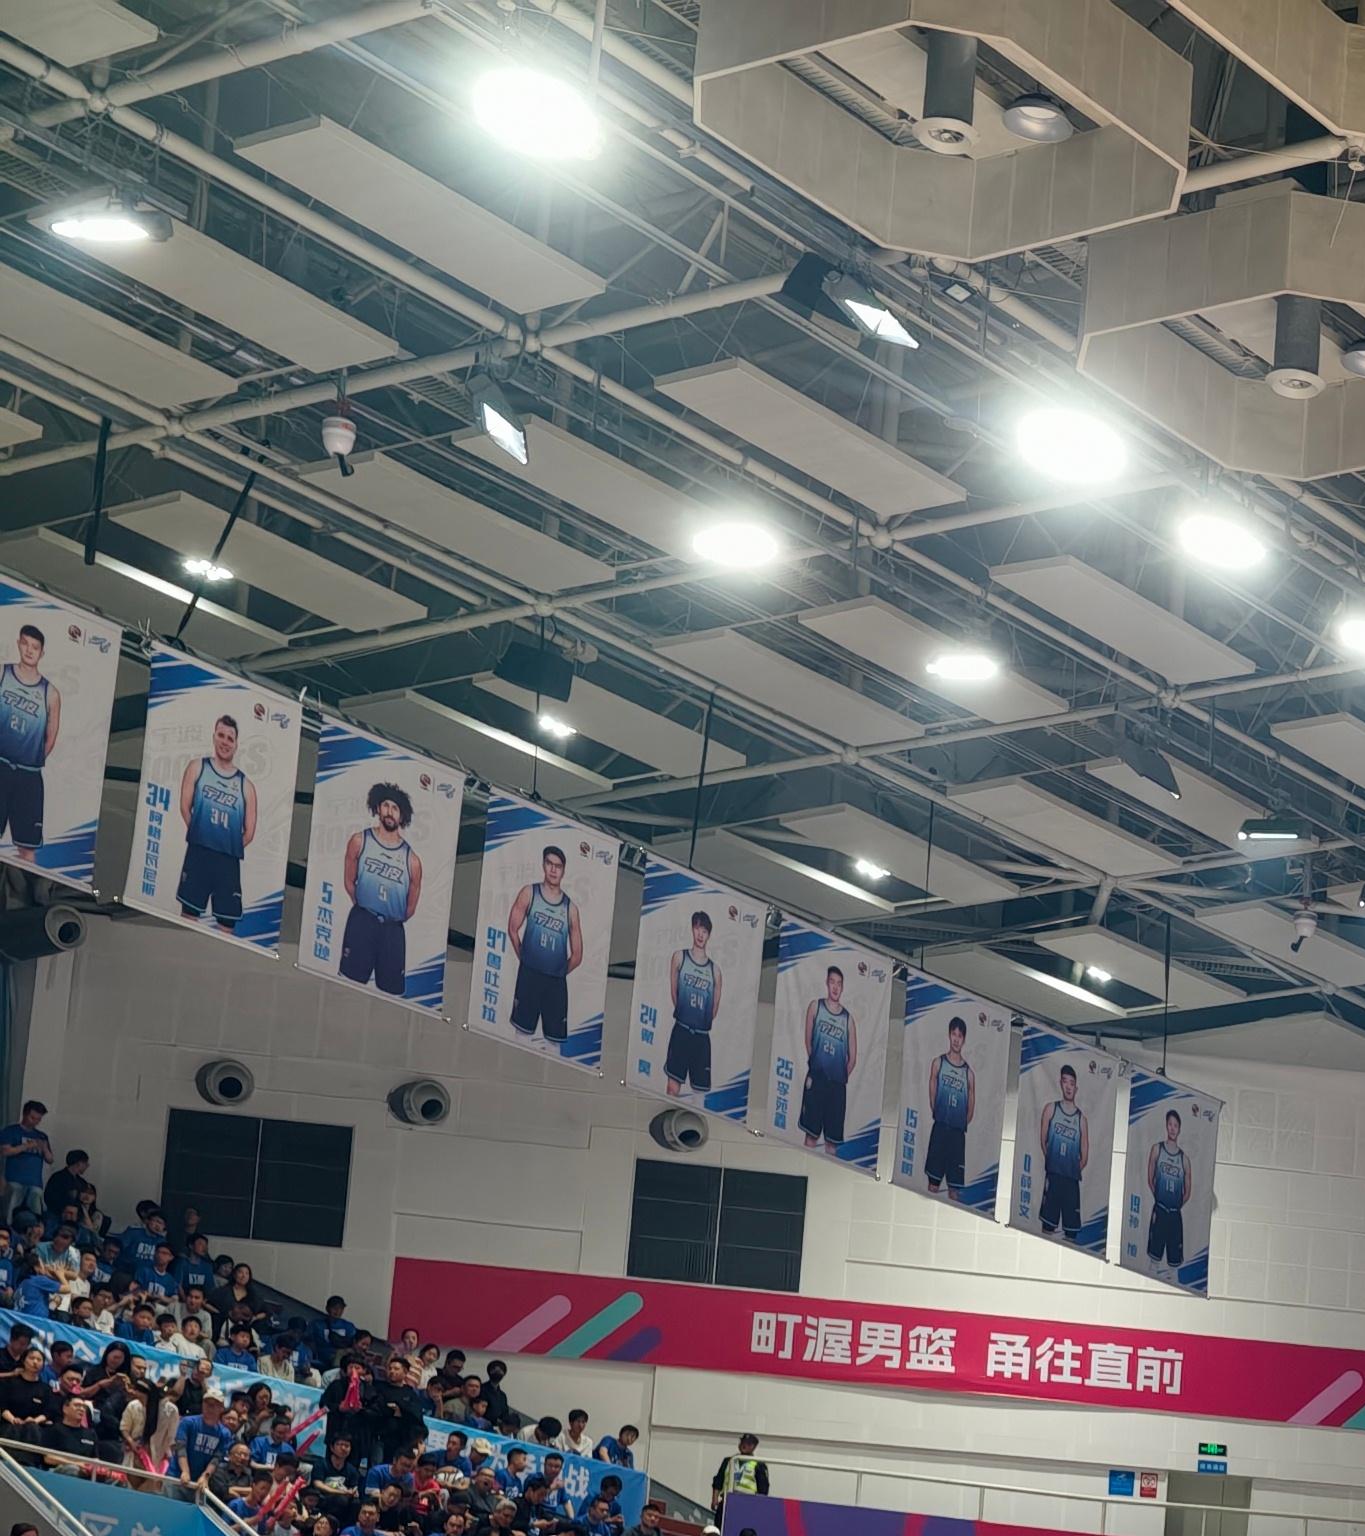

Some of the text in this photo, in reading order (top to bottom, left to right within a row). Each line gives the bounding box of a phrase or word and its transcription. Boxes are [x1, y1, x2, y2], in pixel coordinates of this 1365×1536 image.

[146, 783, 171, 812] 34
[210, 808, 229, 829] 34
[321, 881, 334, 904] 5
[487, 926, 507, 953] 97
[690, 993, 705, 1010] 24
[639, 1003, 657, 1029] 24
[776, 1057, 794, 1081] 25
[906, 1107, 918, 1129] 15
[750, 1309, 1185, 1396] 町渥男篮 甬往直前
